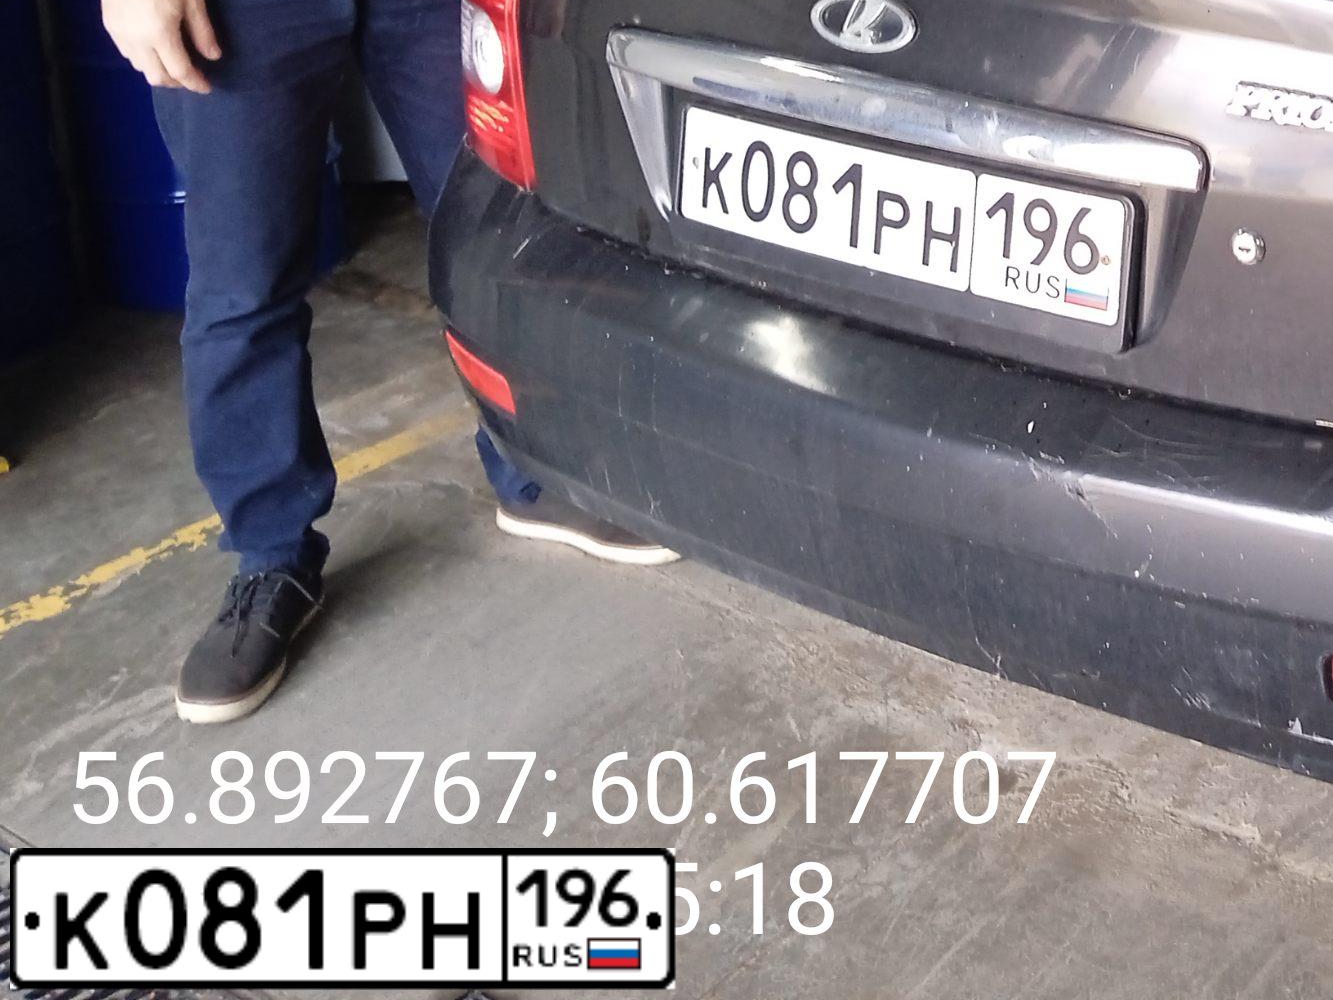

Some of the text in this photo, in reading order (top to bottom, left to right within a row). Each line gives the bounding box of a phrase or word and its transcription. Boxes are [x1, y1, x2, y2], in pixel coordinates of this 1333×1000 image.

[702, 140, 1100, 275] К081РН 196
[1004, 265, 1060, 300] RUS
